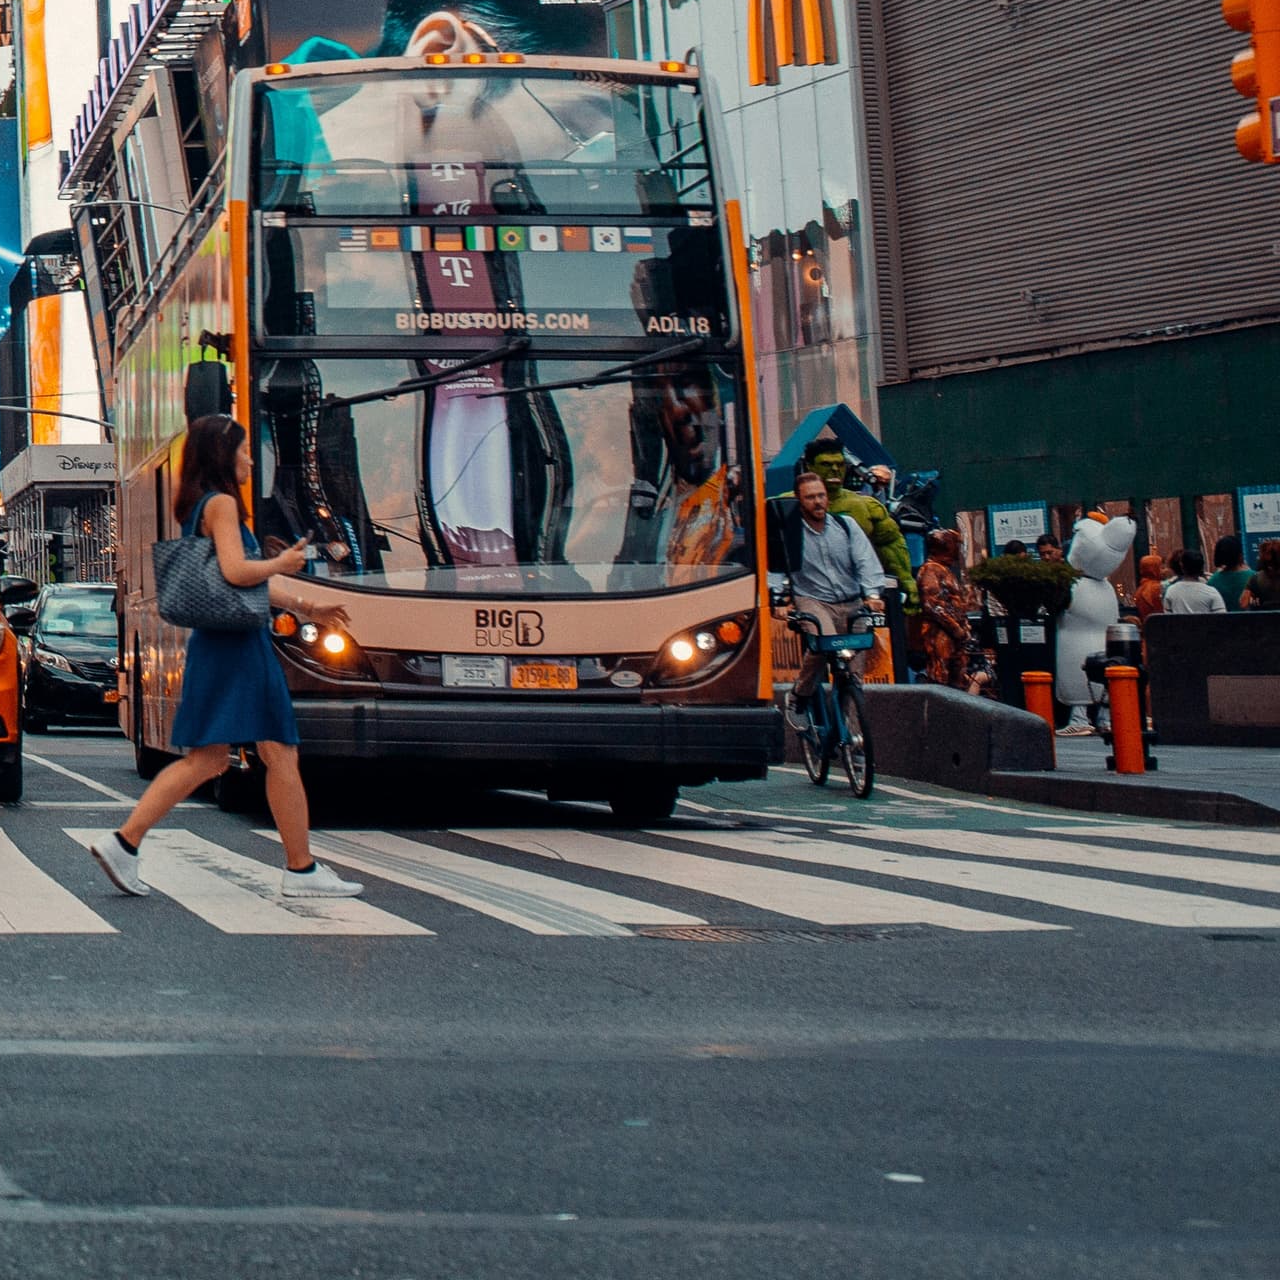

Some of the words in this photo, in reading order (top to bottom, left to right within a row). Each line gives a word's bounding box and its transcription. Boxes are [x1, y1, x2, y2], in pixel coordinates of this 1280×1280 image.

[395, 312, 590, 331] BIGBUSTOURS.COM
[647, 316, 683, 334] ADL
[56, 455, 102, 475] Disney
[104, 461, 118, 470] sto
[475, 609, 513, 628] BIG
[475, 629, 514, 647] BUS
